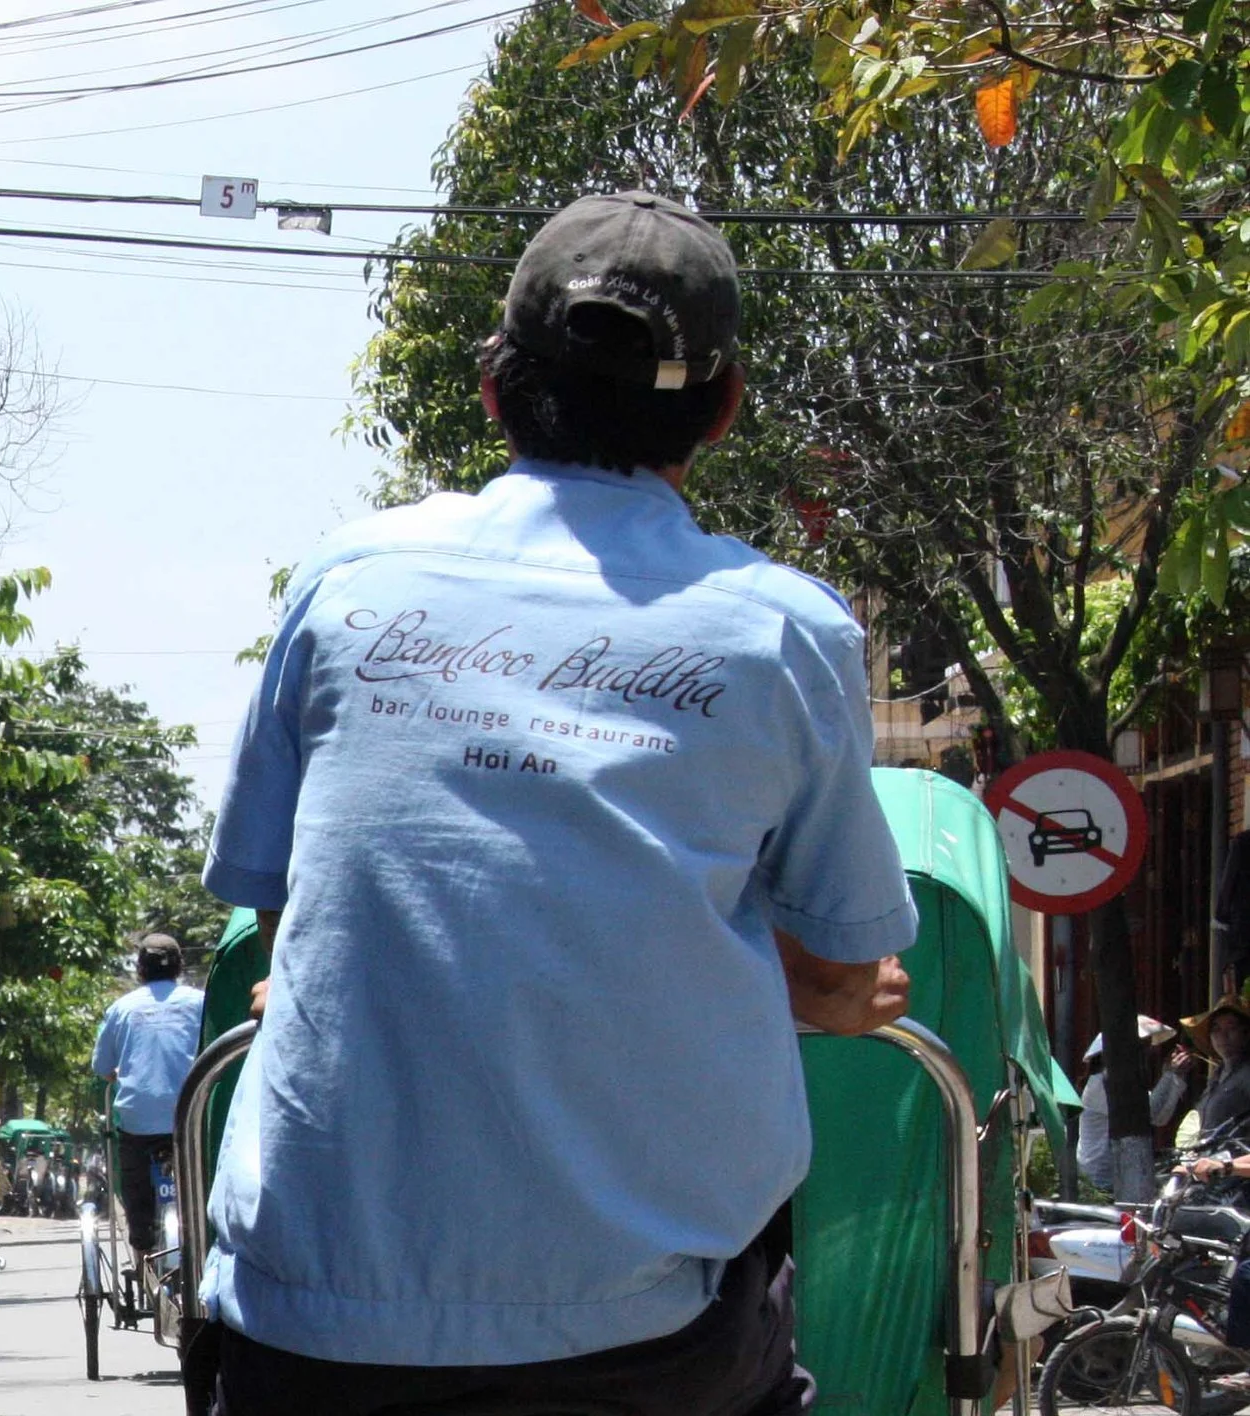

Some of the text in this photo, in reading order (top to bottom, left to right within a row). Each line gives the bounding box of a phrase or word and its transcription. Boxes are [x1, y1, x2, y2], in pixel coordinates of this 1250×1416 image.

[344, 609, 726, 718] Bamboo Buddha
[371, 694, 677, 754] bar lounge restaurant
[463, 747, 557, 775] Hoi An
